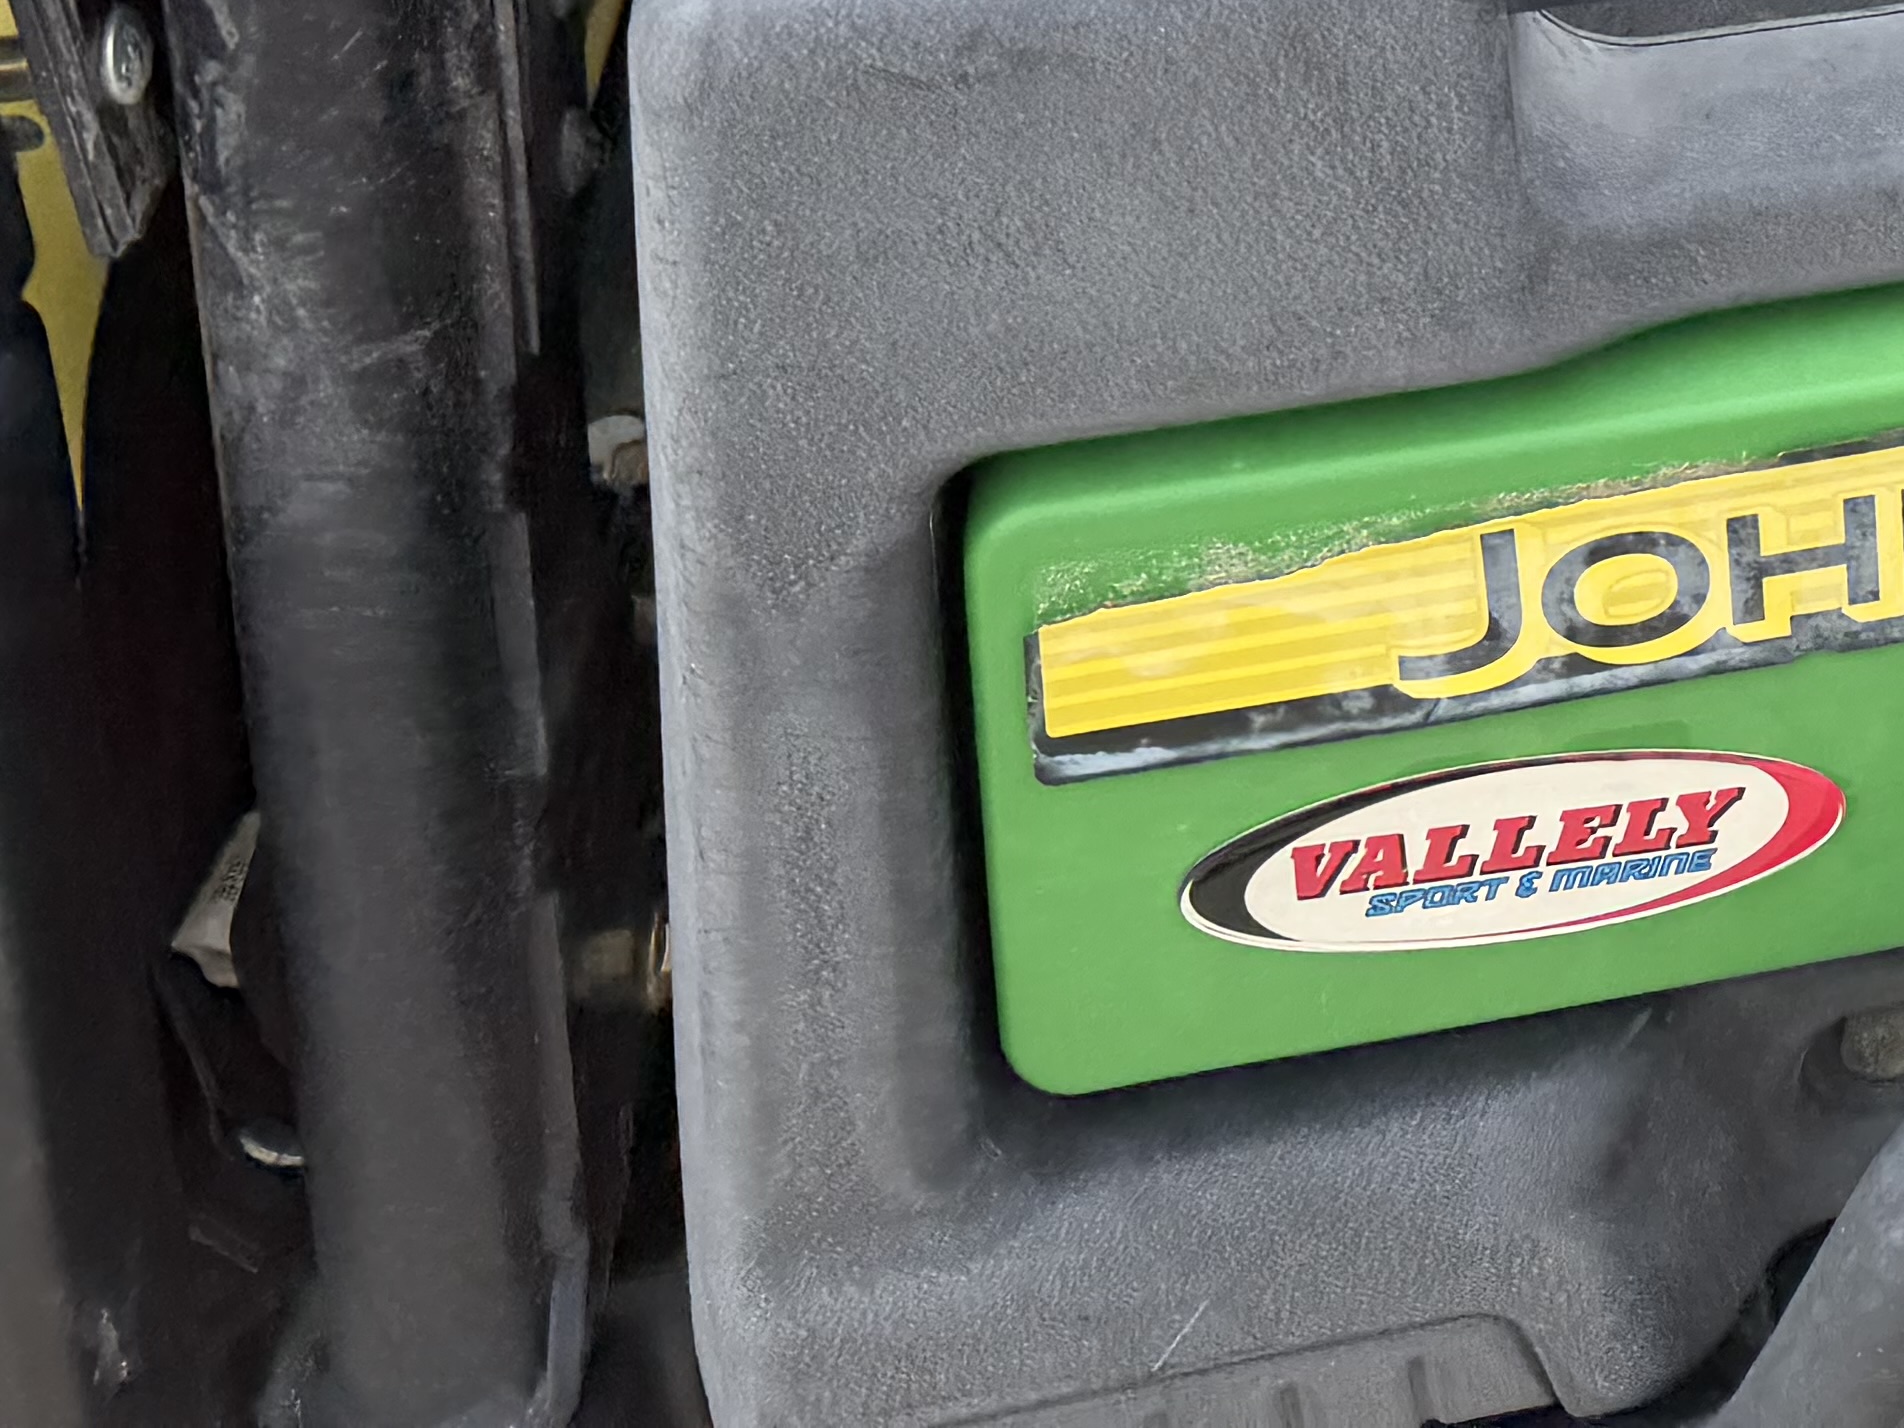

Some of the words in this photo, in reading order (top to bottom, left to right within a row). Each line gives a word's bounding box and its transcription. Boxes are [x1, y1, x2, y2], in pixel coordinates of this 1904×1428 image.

[1290, 786, 1746, 901] VALLELY
[1365, 874, 1511, 918] SPORT
[1514, 870, 1541, 900] &
[1550, 847, 1718, 894] MARINE
